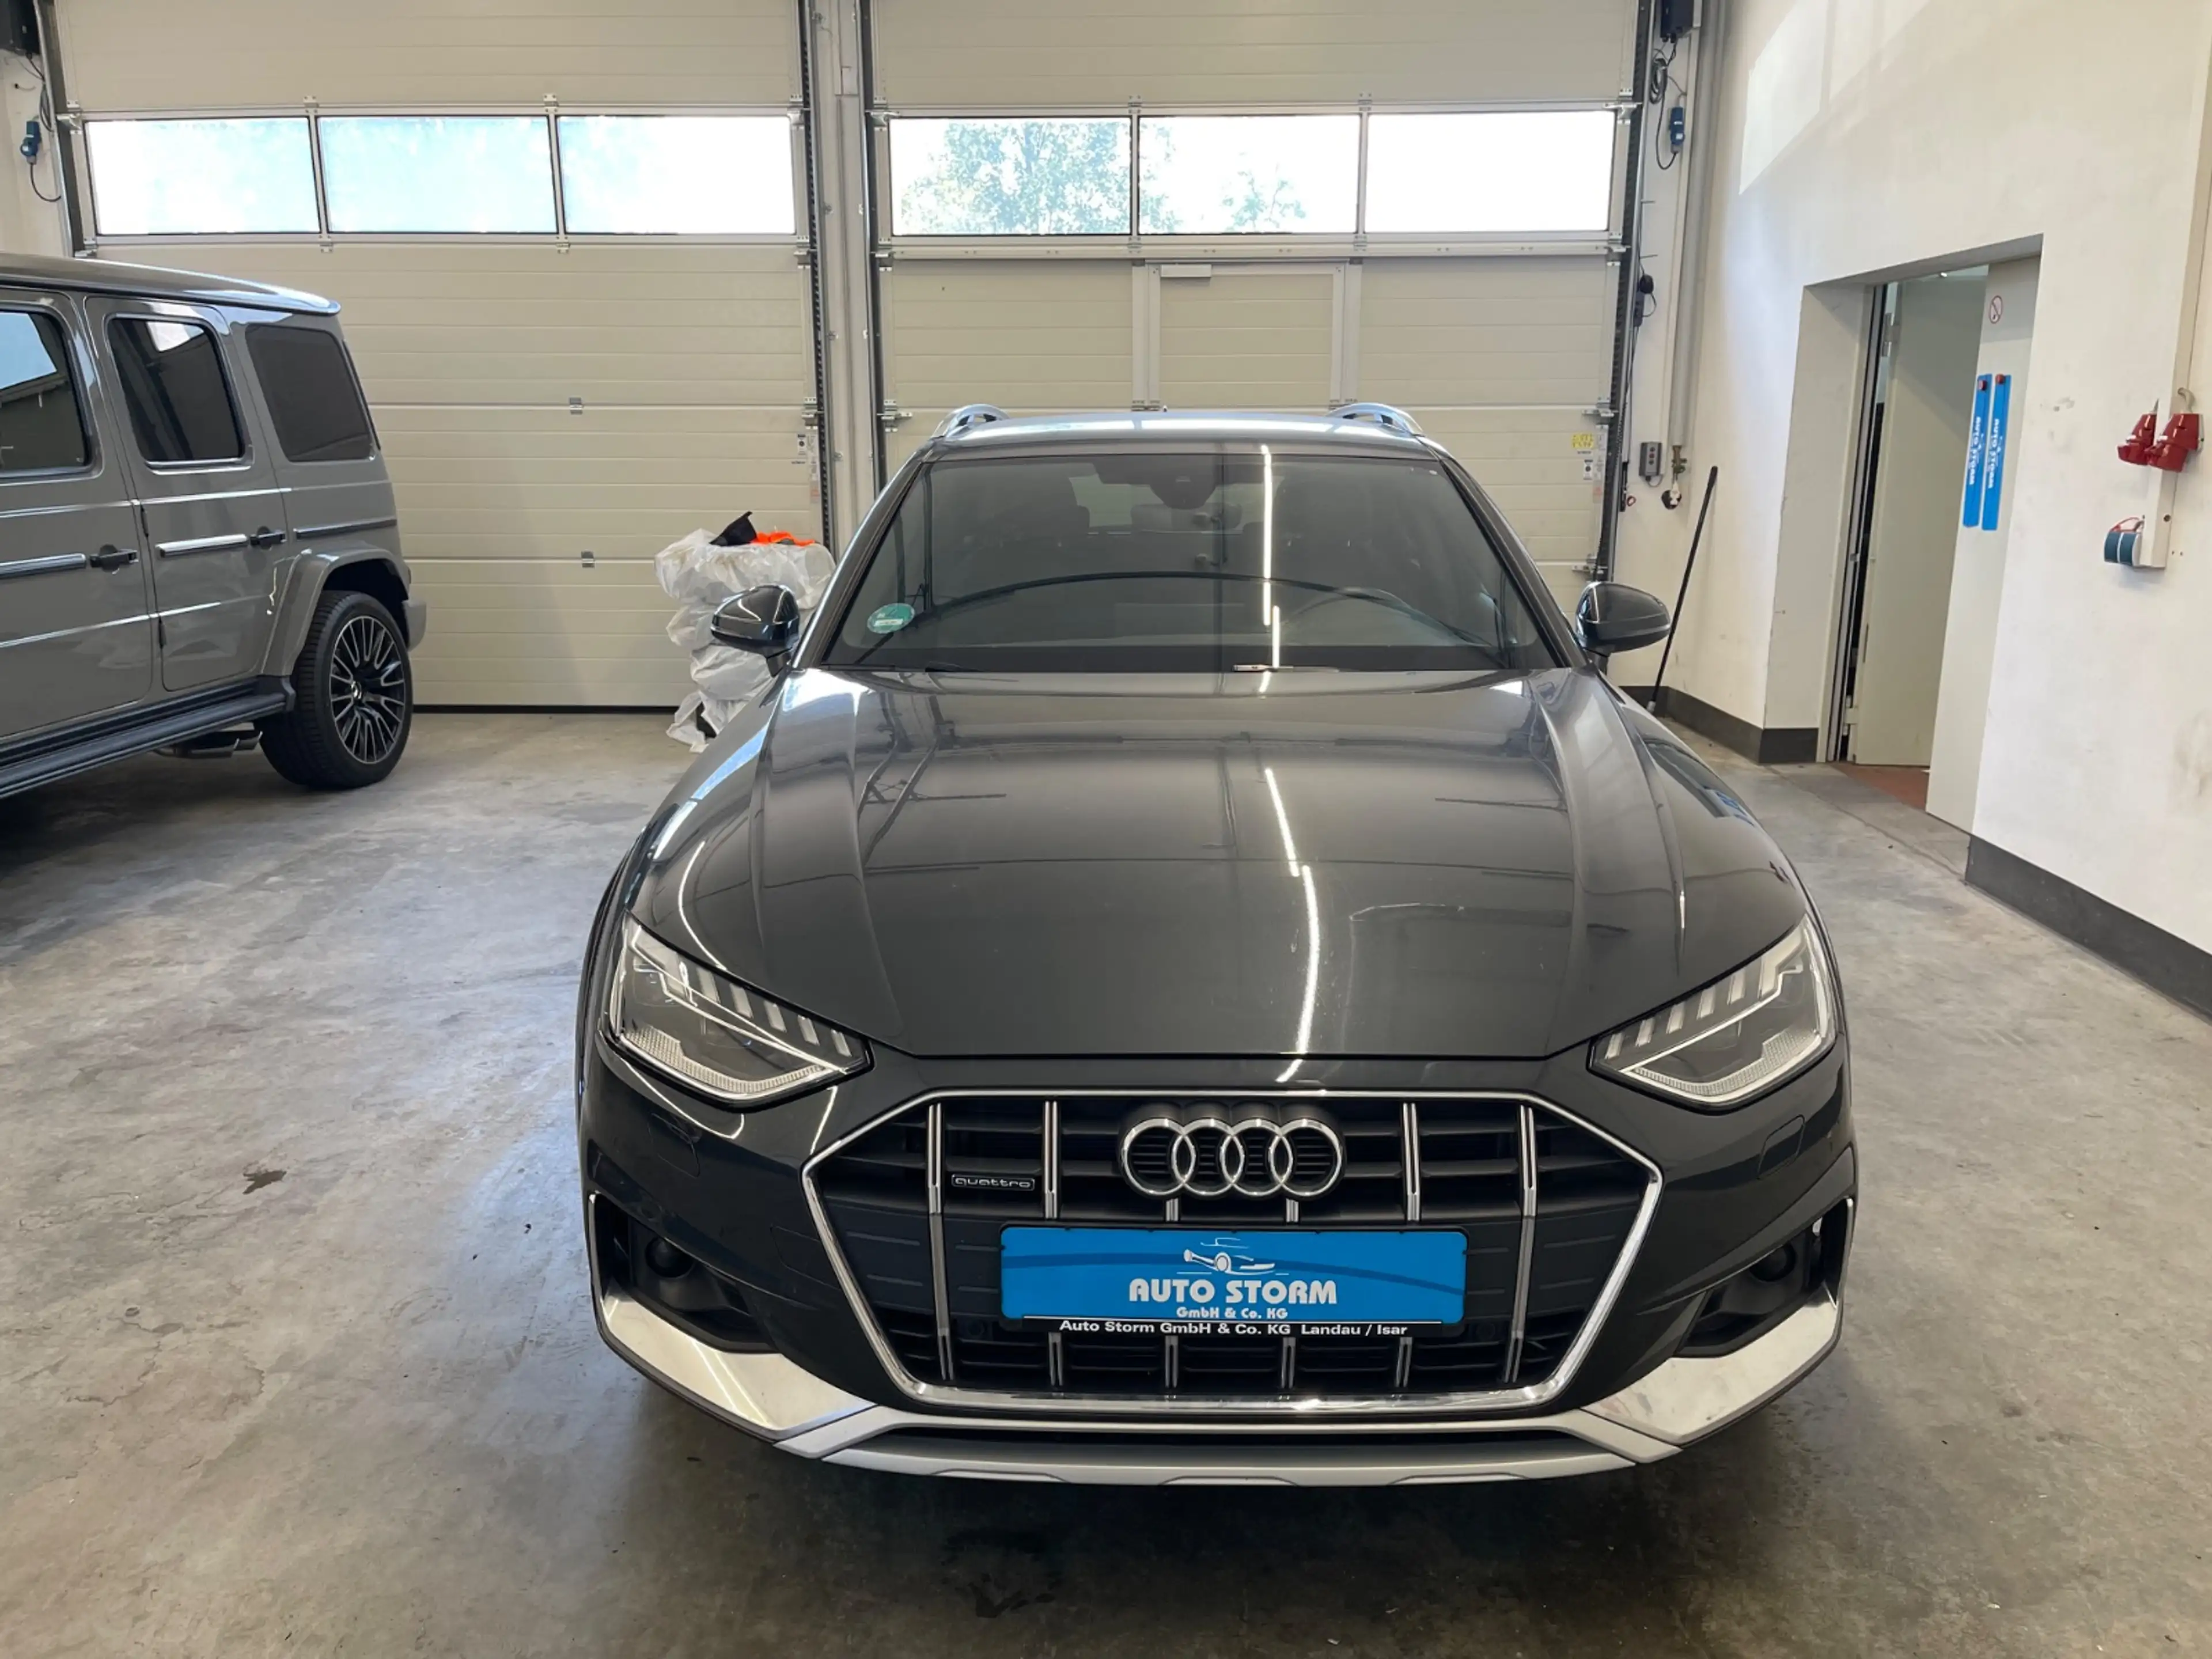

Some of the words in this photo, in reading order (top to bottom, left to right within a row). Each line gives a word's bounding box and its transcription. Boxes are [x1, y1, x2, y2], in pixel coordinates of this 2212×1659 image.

[955, 1177, 1031, 1188] quattro
[1129, 1278, 1215, 1303] AUTO
[1225, 1281, 1337, 1304] STORM
[1176, 1306, 1219, 1319] GmbH
[1225, 1308, 1236, 1318] &
[1241, 1308, 1262, 1319] Co.
[1267, 1308, 1288, 1319] KG
[1059, 1320, 1100, 1332] Auto
[1104, 1321, 1155, 1333] Storm
[1160, 1322, 1211, 1334] GmbH
[1217, 1324, 1230, 1334] &
[1235, 1324, 1262, 1335] Co.
[1267, 1324, 1291, 1335] KG
[1301, 1324, 1361, 1335] Landau
[1365, 1325, 1372, 1336] /
[1377, 1325, 1407, 1336] Isar
